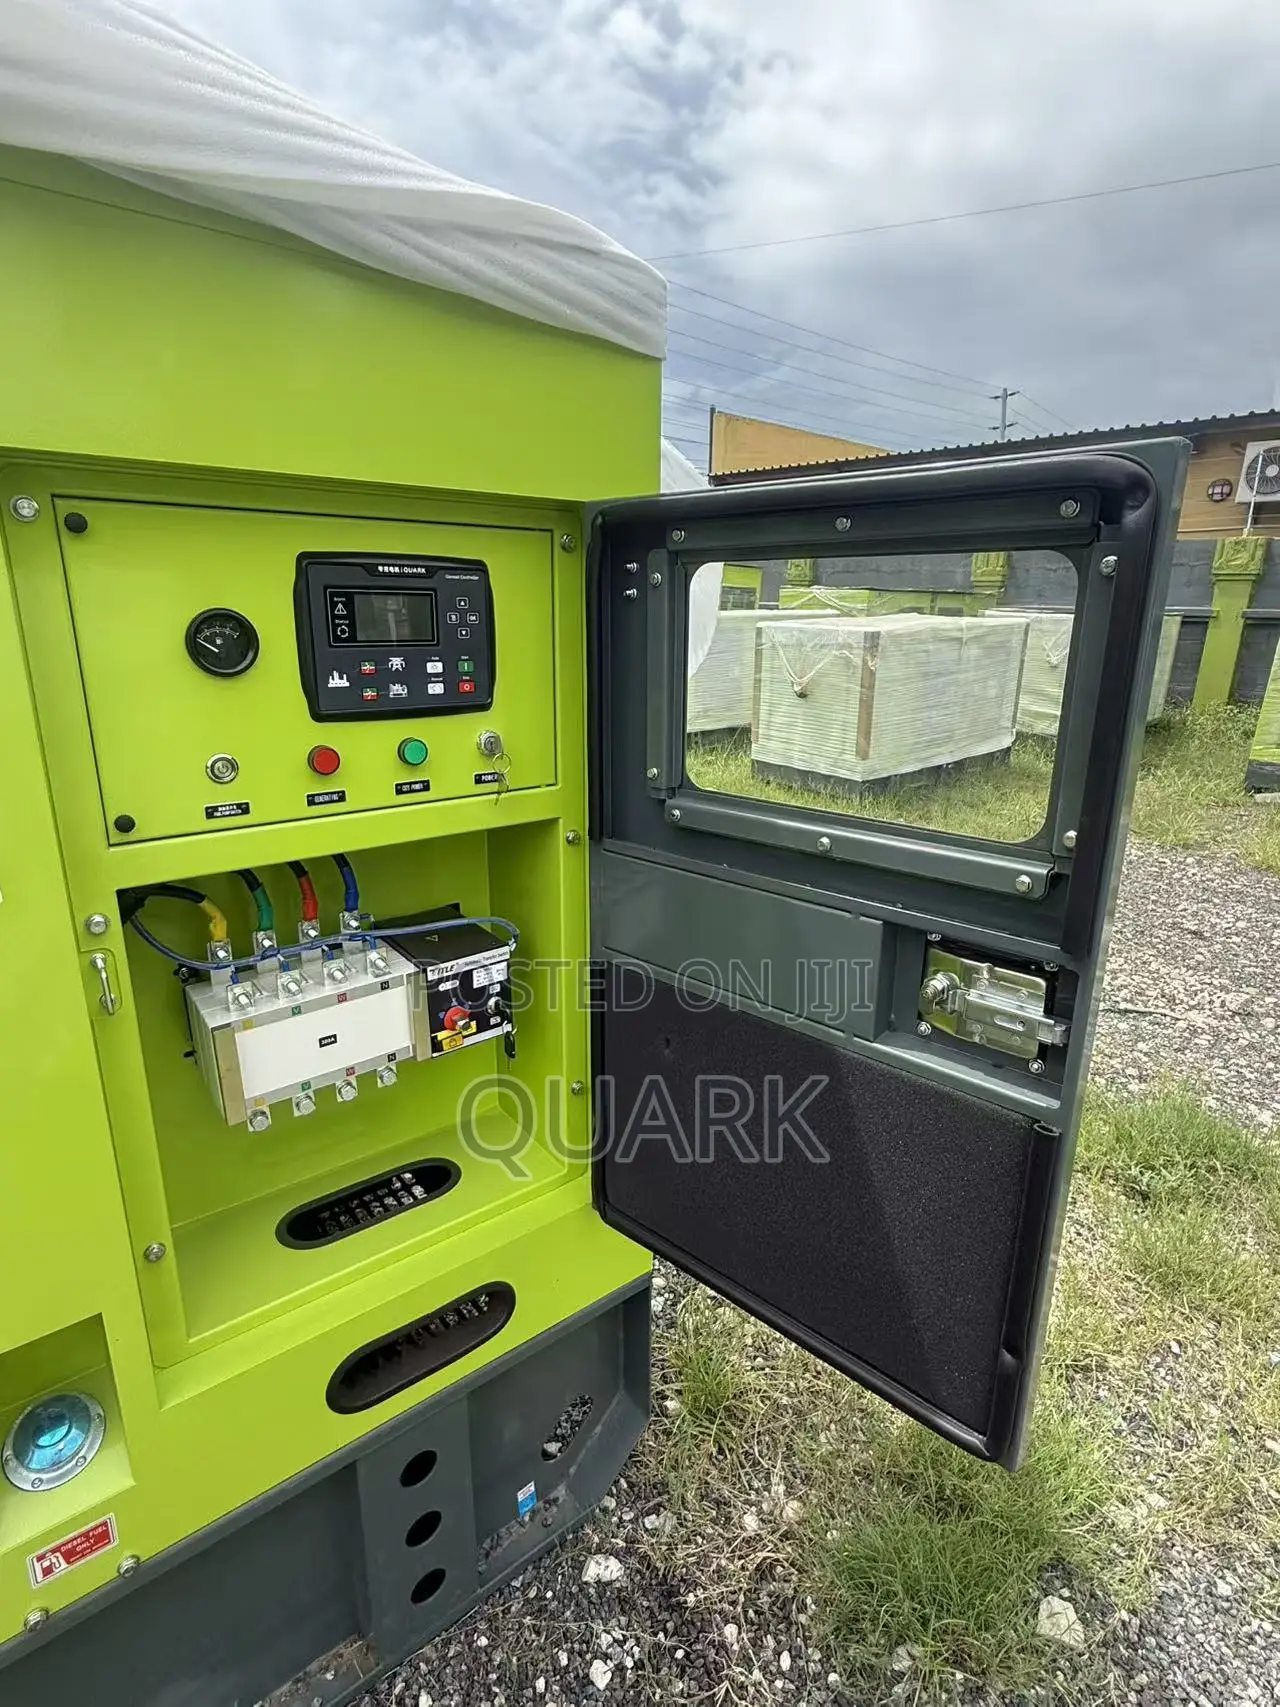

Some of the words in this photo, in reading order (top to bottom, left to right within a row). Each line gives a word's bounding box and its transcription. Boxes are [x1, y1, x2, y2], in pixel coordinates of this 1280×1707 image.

[402, 566, 426, 574] QUARK
[61, 1536, 86, 1552] DIESEL
[89, 1525, 107, 1537] FUEL
[76, 1539, 95, 1552] ONLY
